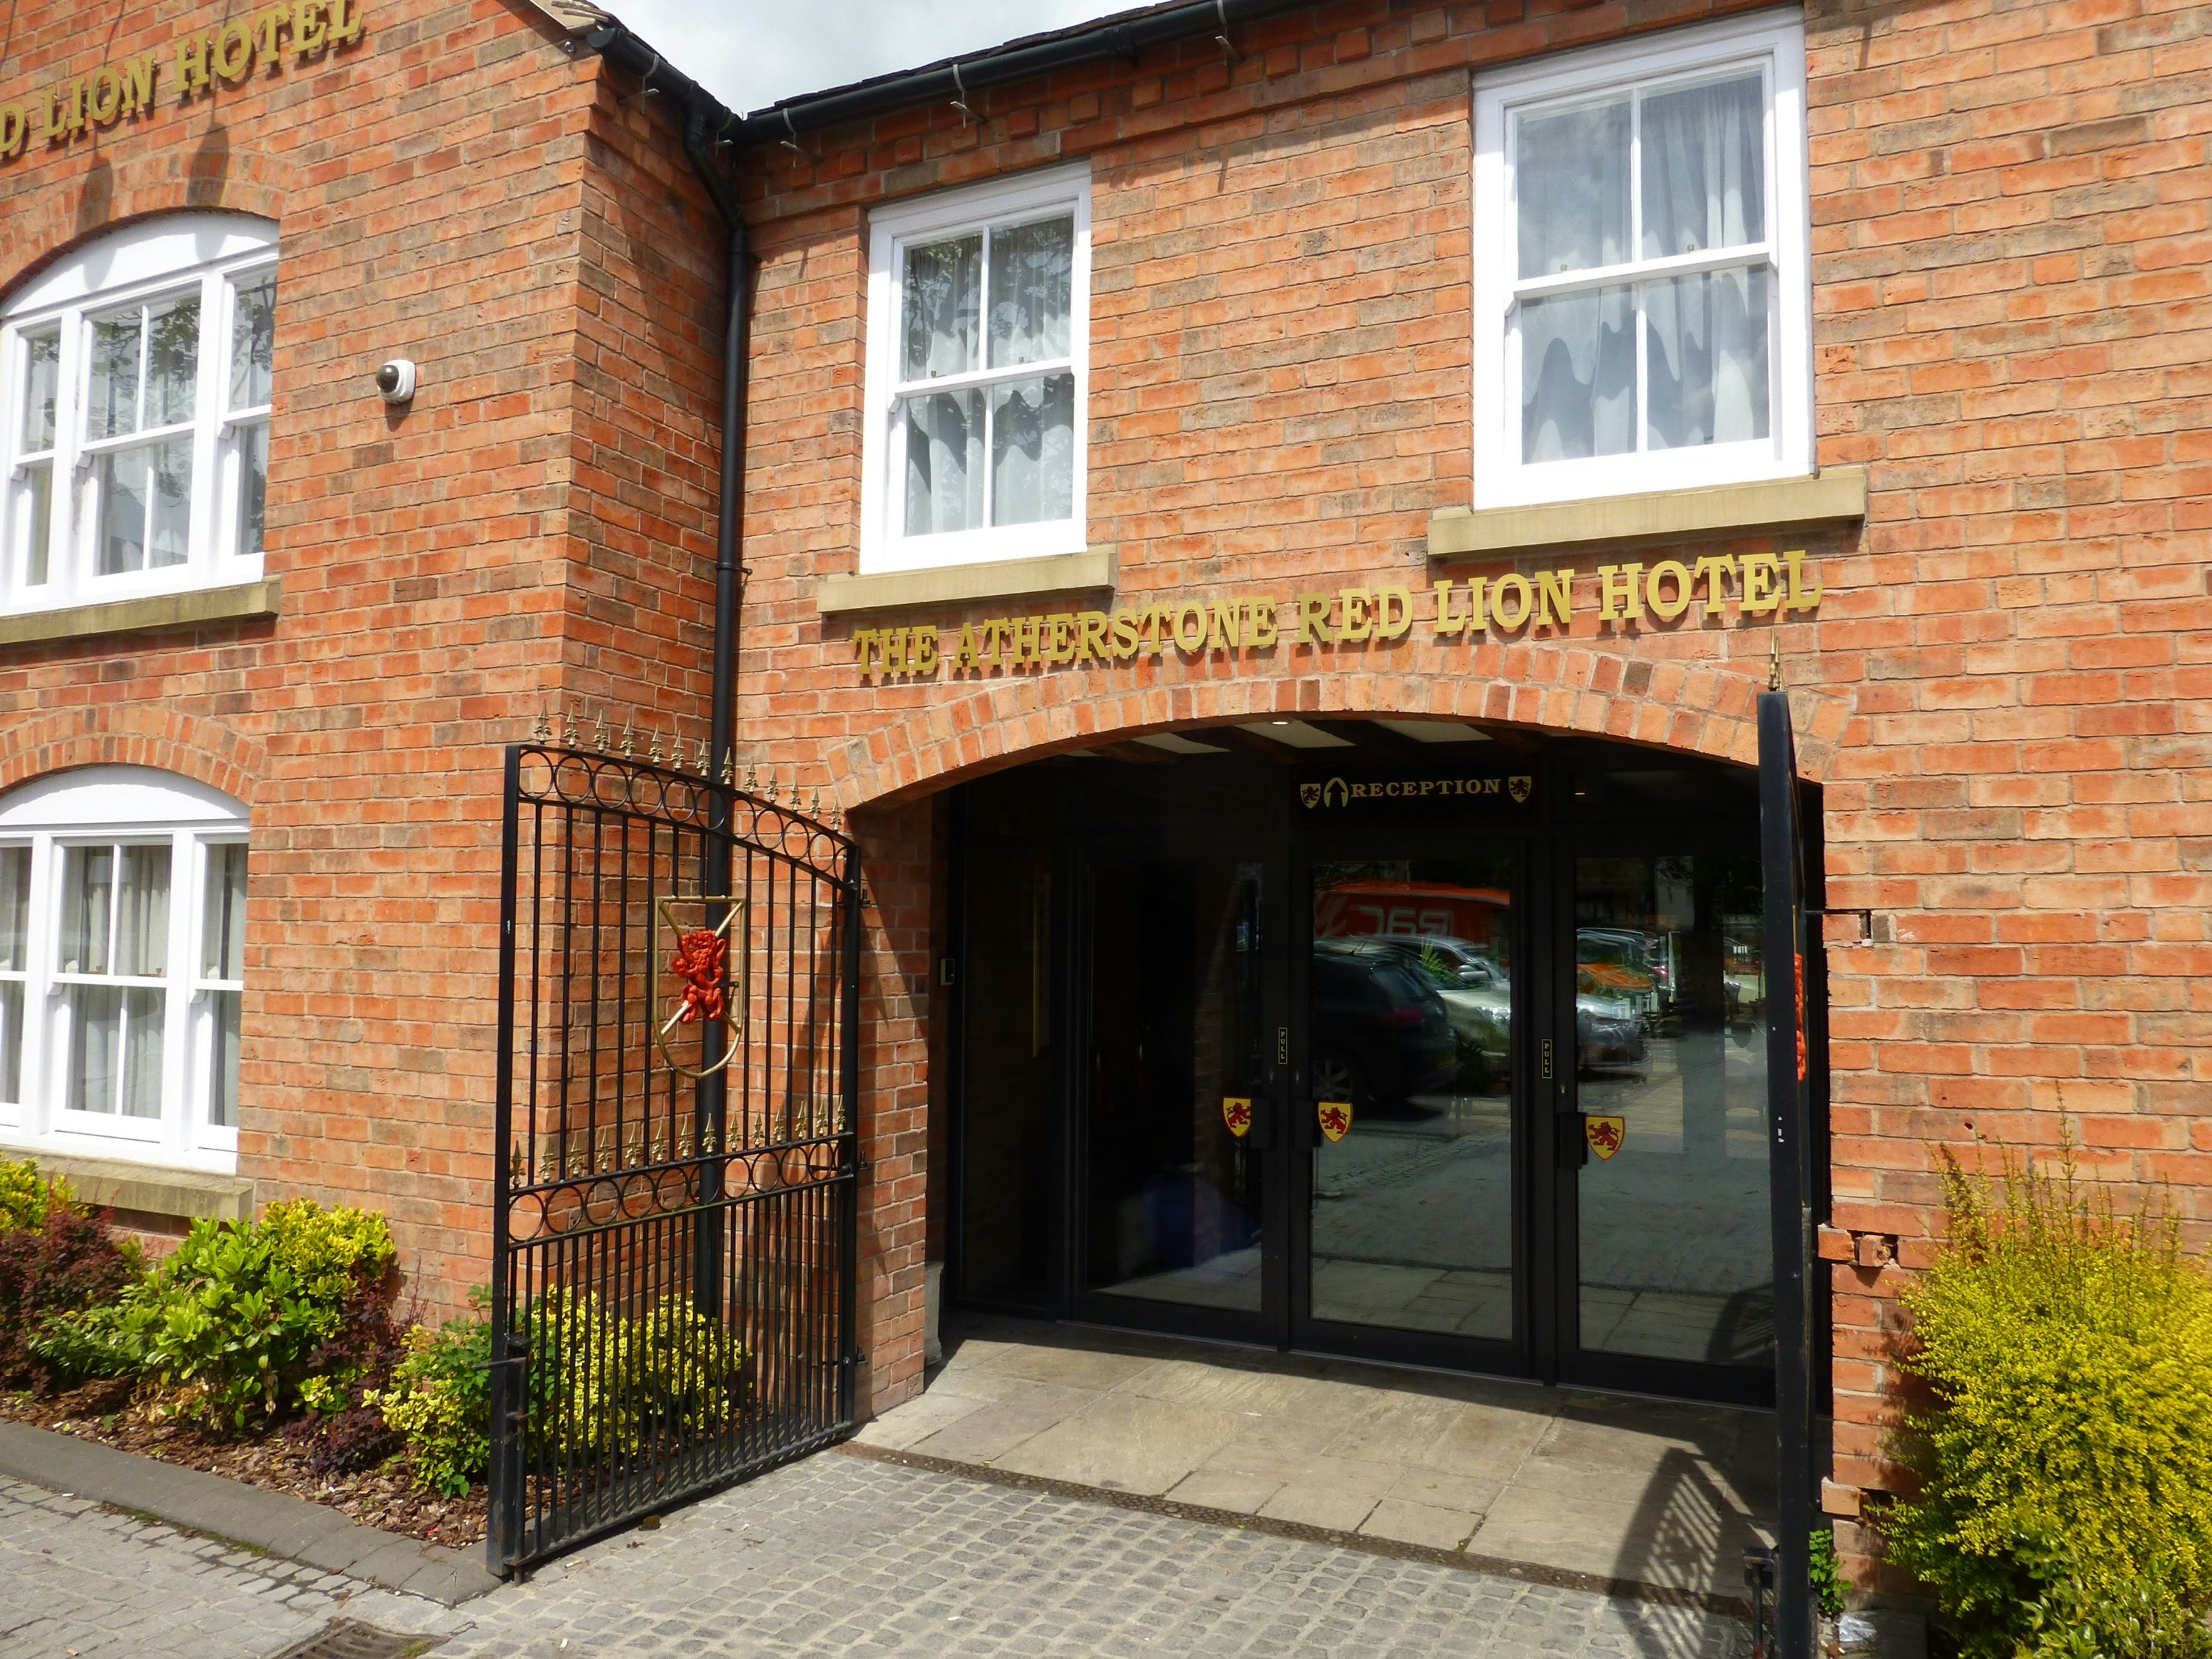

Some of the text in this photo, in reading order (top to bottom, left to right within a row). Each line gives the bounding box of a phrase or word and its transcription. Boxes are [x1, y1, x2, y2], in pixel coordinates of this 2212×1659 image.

[41, 54, 156, 140] LION
[173, 0, 364, 94] HOTEL
[852, 549, 1823, 675] THE ATHERSTONE RED LION HOTEL
[1350, 779, 1501, 798] RECEPTION
